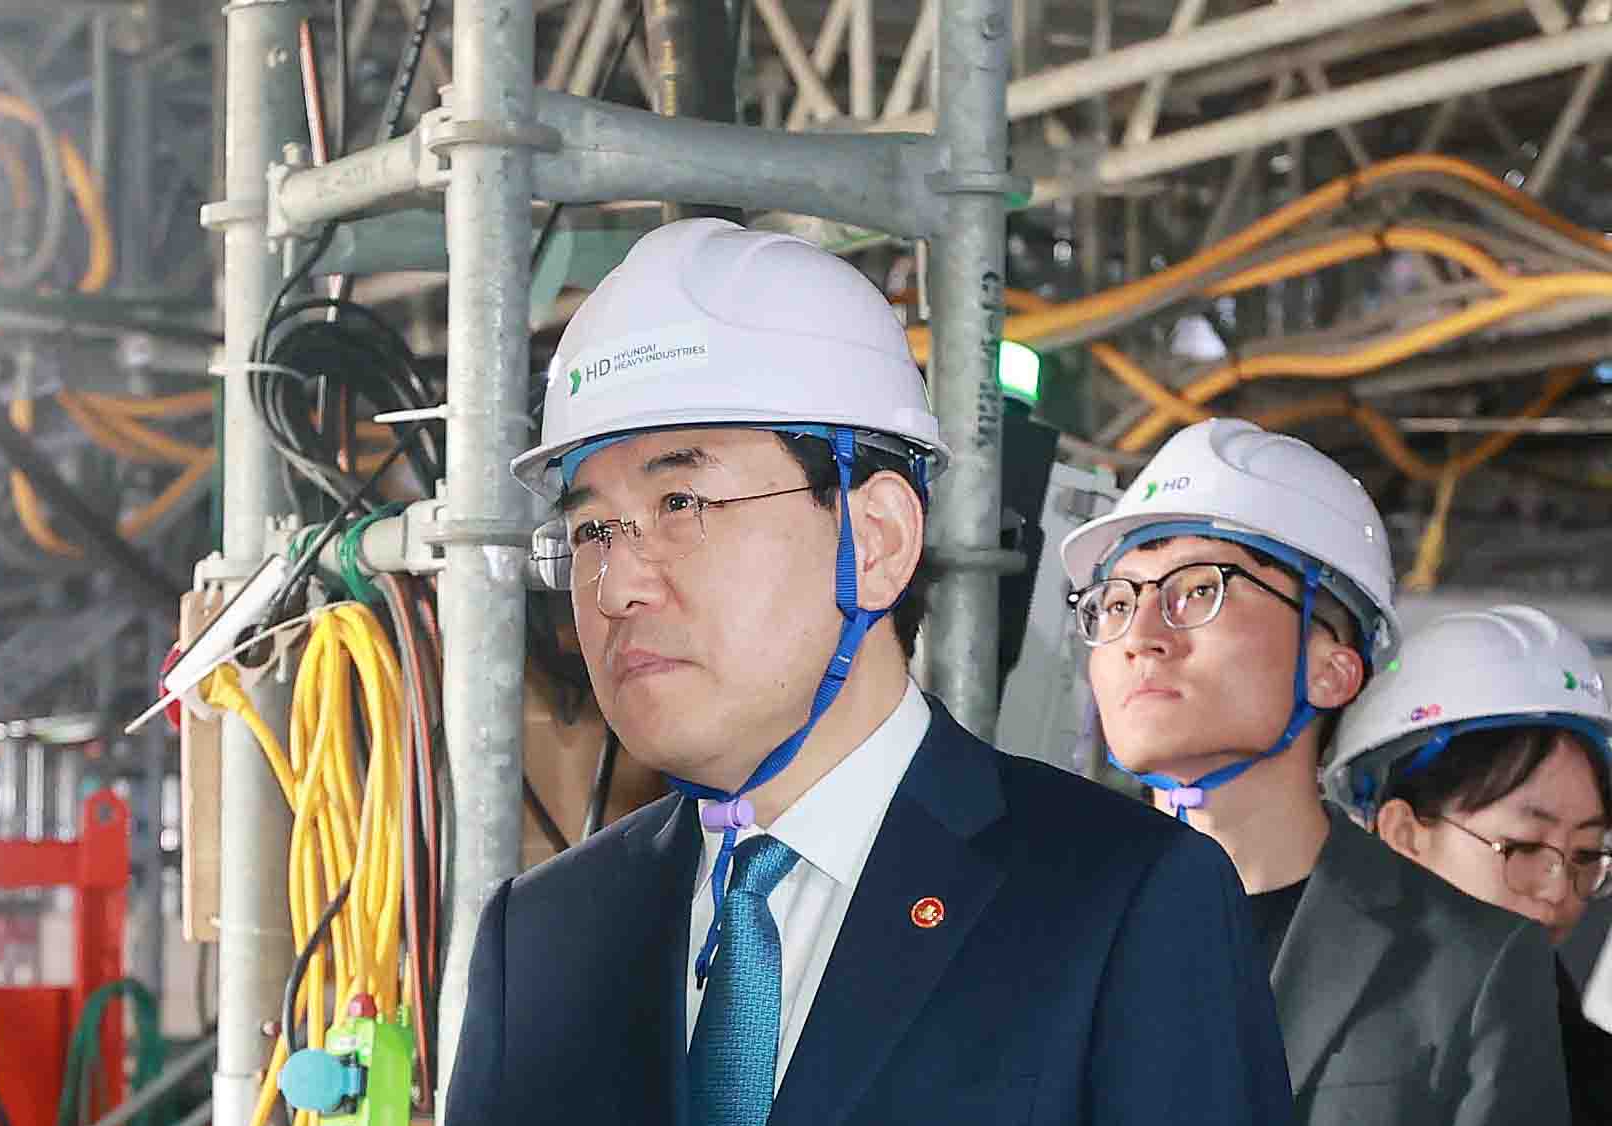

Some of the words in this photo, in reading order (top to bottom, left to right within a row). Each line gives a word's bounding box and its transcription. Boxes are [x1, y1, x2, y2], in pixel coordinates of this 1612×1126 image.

[614, 343, 657, 361] HYUNDAI
[614, 356, 644, 372] HEAVY
[645, 344, 706, 362] INDUSTRIES
[585, 359, 611, 383] HD
